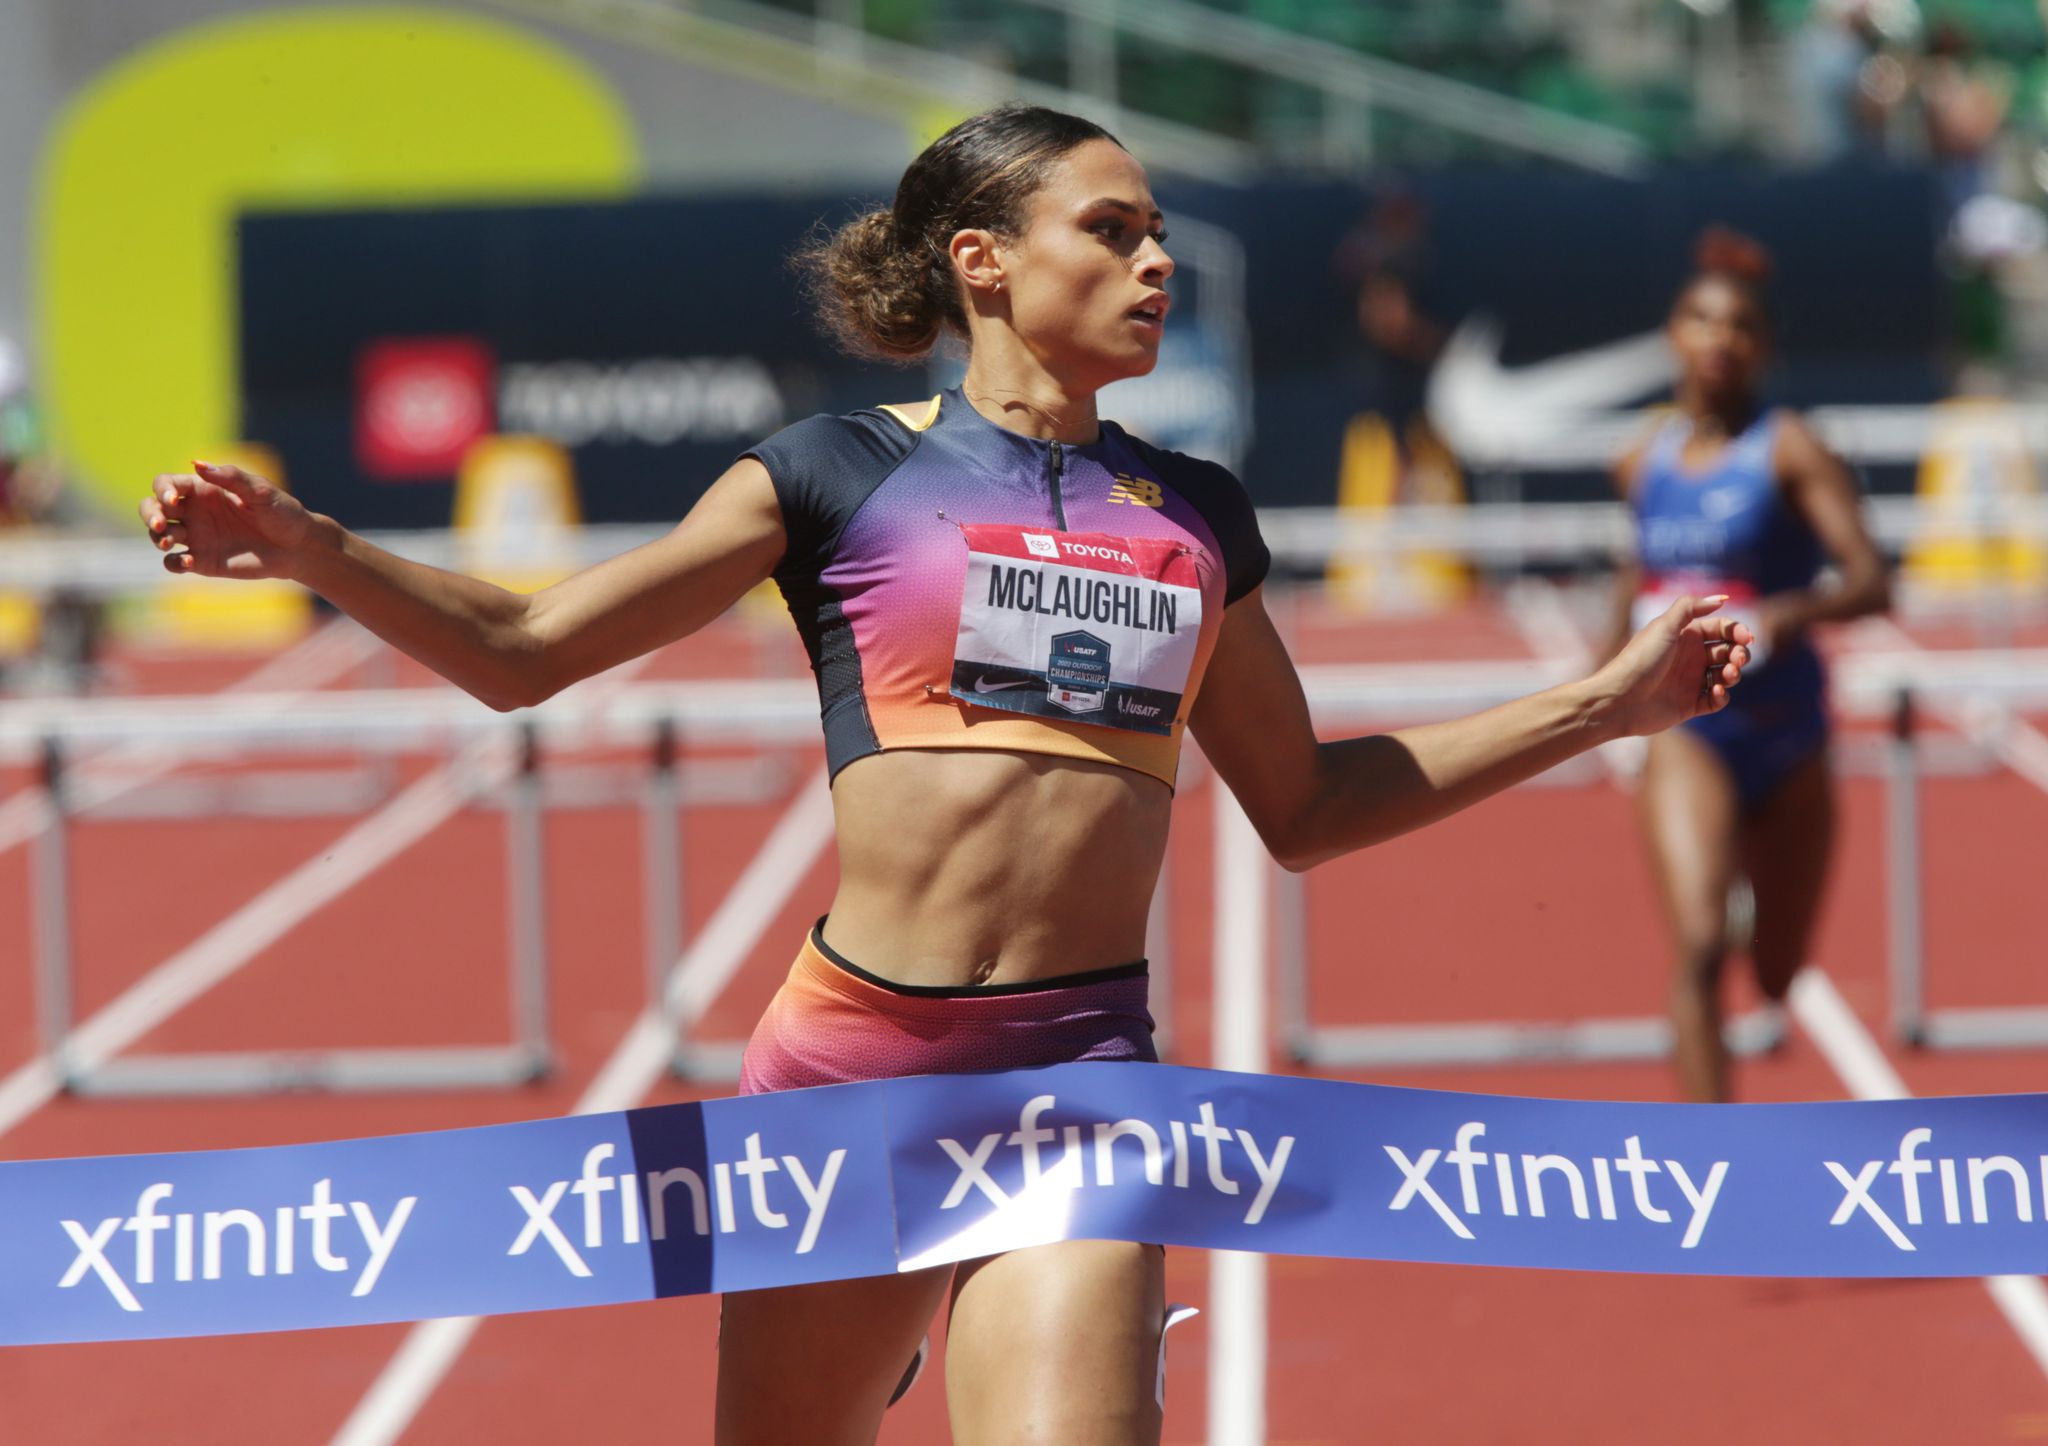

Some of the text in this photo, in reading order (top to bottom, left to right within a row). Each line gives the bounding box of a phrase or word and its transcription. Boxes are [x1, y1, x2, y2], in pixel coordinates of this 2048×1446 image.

[1061, 542, 1134, 564] TOYOTA
[988, 564, 1177, 635] MCLAUGHLIN
[1074, 646, 1097, 656] USATF
[1071, 662, 1103, 671] OUTDOOR
[1050, 667, 1106, 684] CHAMPIONSHIPS
[1130, 703, 1160, 717] USATF
[57, 1178, 418, 1311] xfinity
[508, 1131, 847, 1277] xfinity
[936, 1095, 1295, 1225] xfinity
[1383, 1122, 1729, 1249] xfinity
